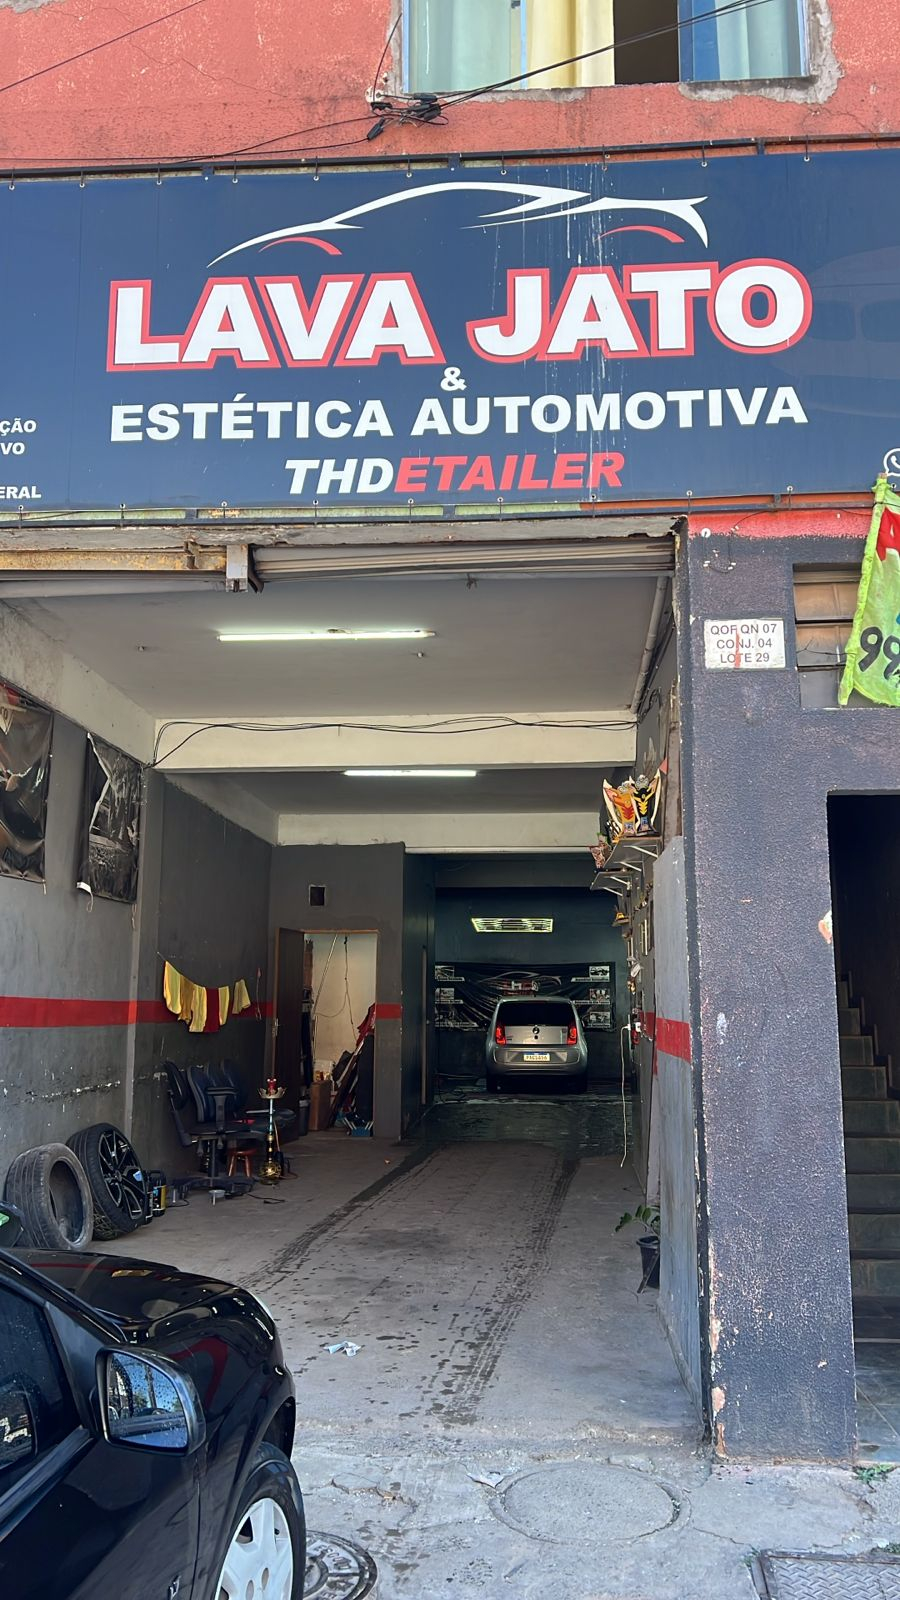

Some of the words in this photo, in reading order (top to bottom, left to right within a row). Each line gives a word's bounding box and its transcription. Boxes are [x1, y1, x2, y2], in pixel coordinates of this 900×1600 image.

[106, 272, 446, 372] LAVA
[466, 257, 812, 363] JATO
[440, 366, 467, 392] &
[110, 393, 393, 442] ESTÉTICA
[410, 386, 808, 436] AUTOMOTIVA
[0, 442, 25, 455] VO
[284, 451, 625, 494] THDETAILER
[740, 624, 759, 635] QN
[762, 623, 777, 634] 07
[716, 638, 755, 649] CONJ.
[757, 638, 773, 648] 04
[720, 652, 752, 663] LOTE
[755, 652, 770, 663] 29
